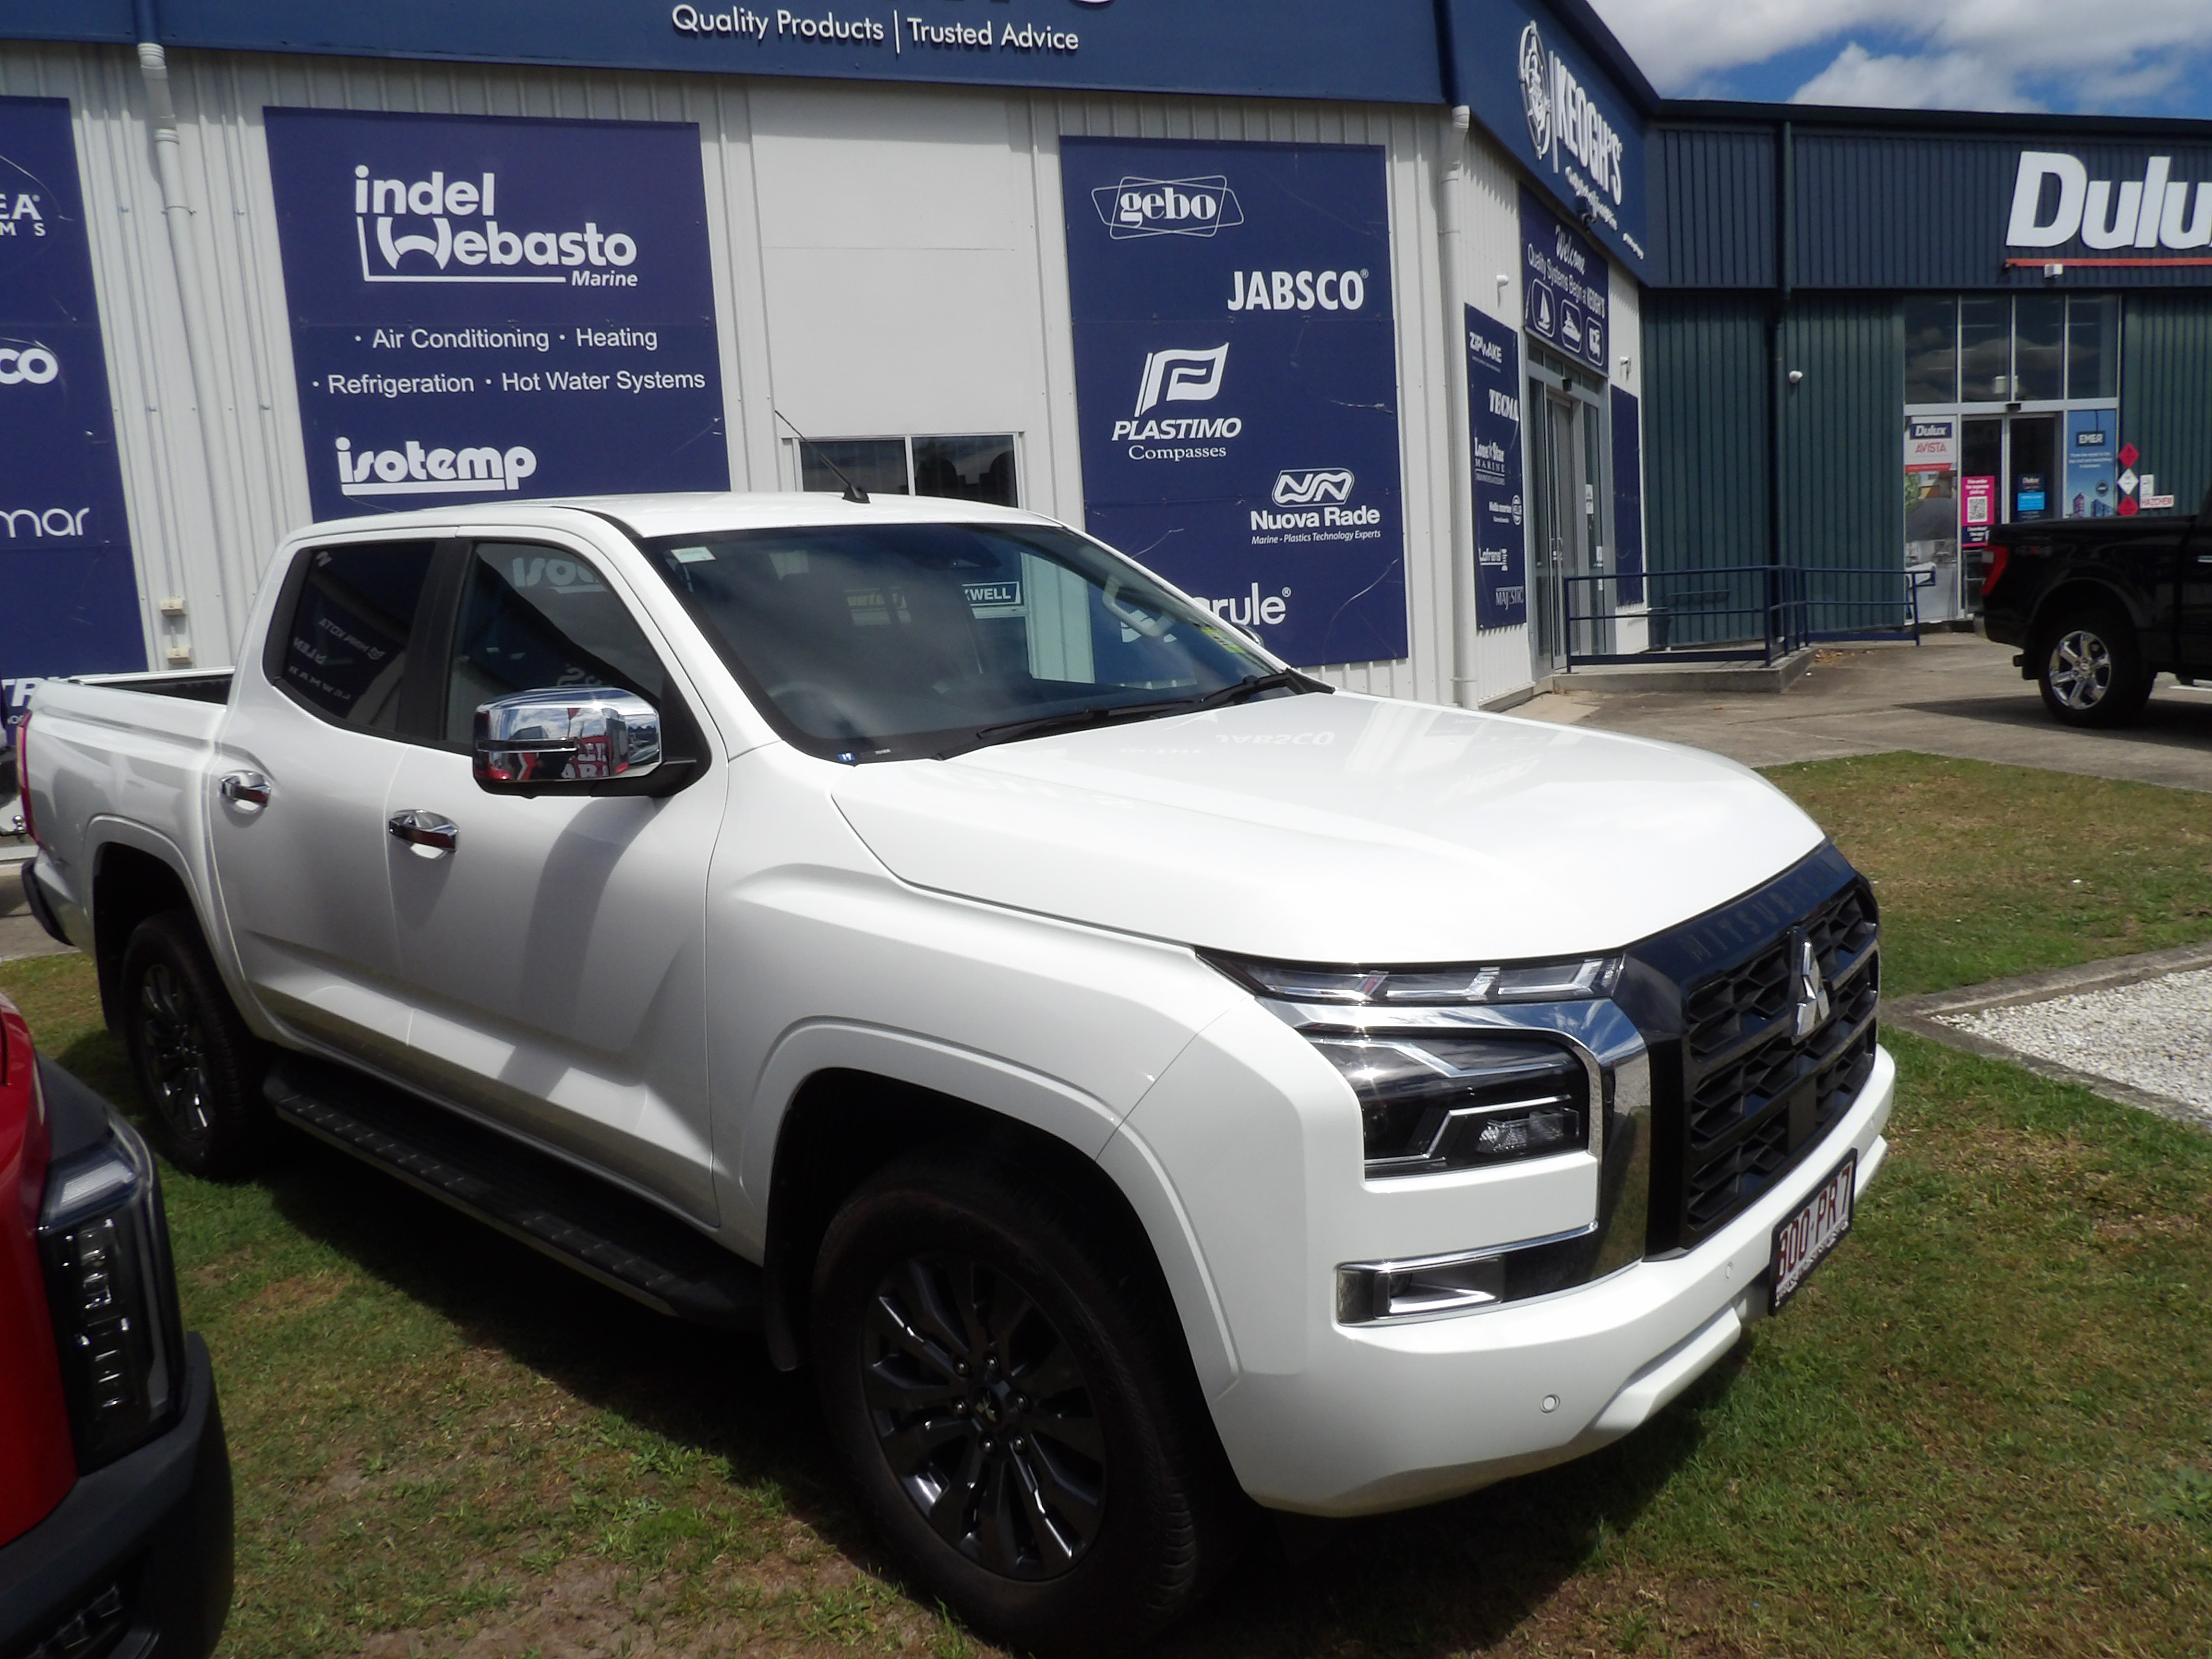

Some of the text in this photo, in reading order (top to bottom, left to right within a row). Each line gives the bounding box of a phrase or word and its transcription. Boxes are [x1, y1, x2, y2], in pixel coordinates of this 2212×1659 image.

[672, 4, 1079, 50] Quality Products Trusted Advice
[1554, 57, 1623, 206] KEOGH'S
[355, 165, 494, 216] indel
[2006, 151, 2212, 250] Dulu
[1119, 187, 1217, 228] gebo
[377, 217, 637, 270] Webasto
[571, 270, 638, 287] Marine
[1528, 243, 1546, 280] Quality
[1547, 258, 1568, 292] Systems
[373, 327, 658, 352] Air Conditioning Heating
[328, 370, 706, 398] Refrigeration Hot Water Systems
[1489, 388, 1519, 422] TECMA
[1111, 416, 1242, 441] PLASTIMO
[1915, 424, 1947, 437] Dulux
[1128, 445, 1227, 462] Compasses
[1915, 442, 1947, 453] AVISTA
[336, 437, 537, 490] isotemp
[1475, 458, 1505, 473] MARINE
[2141, 496, 2173, 505] HAZCHEM
[1250, 505, 1381, 531] Nuova Rade
[1251, 529, 1381, 545] Marine Plastics Technology Experts
